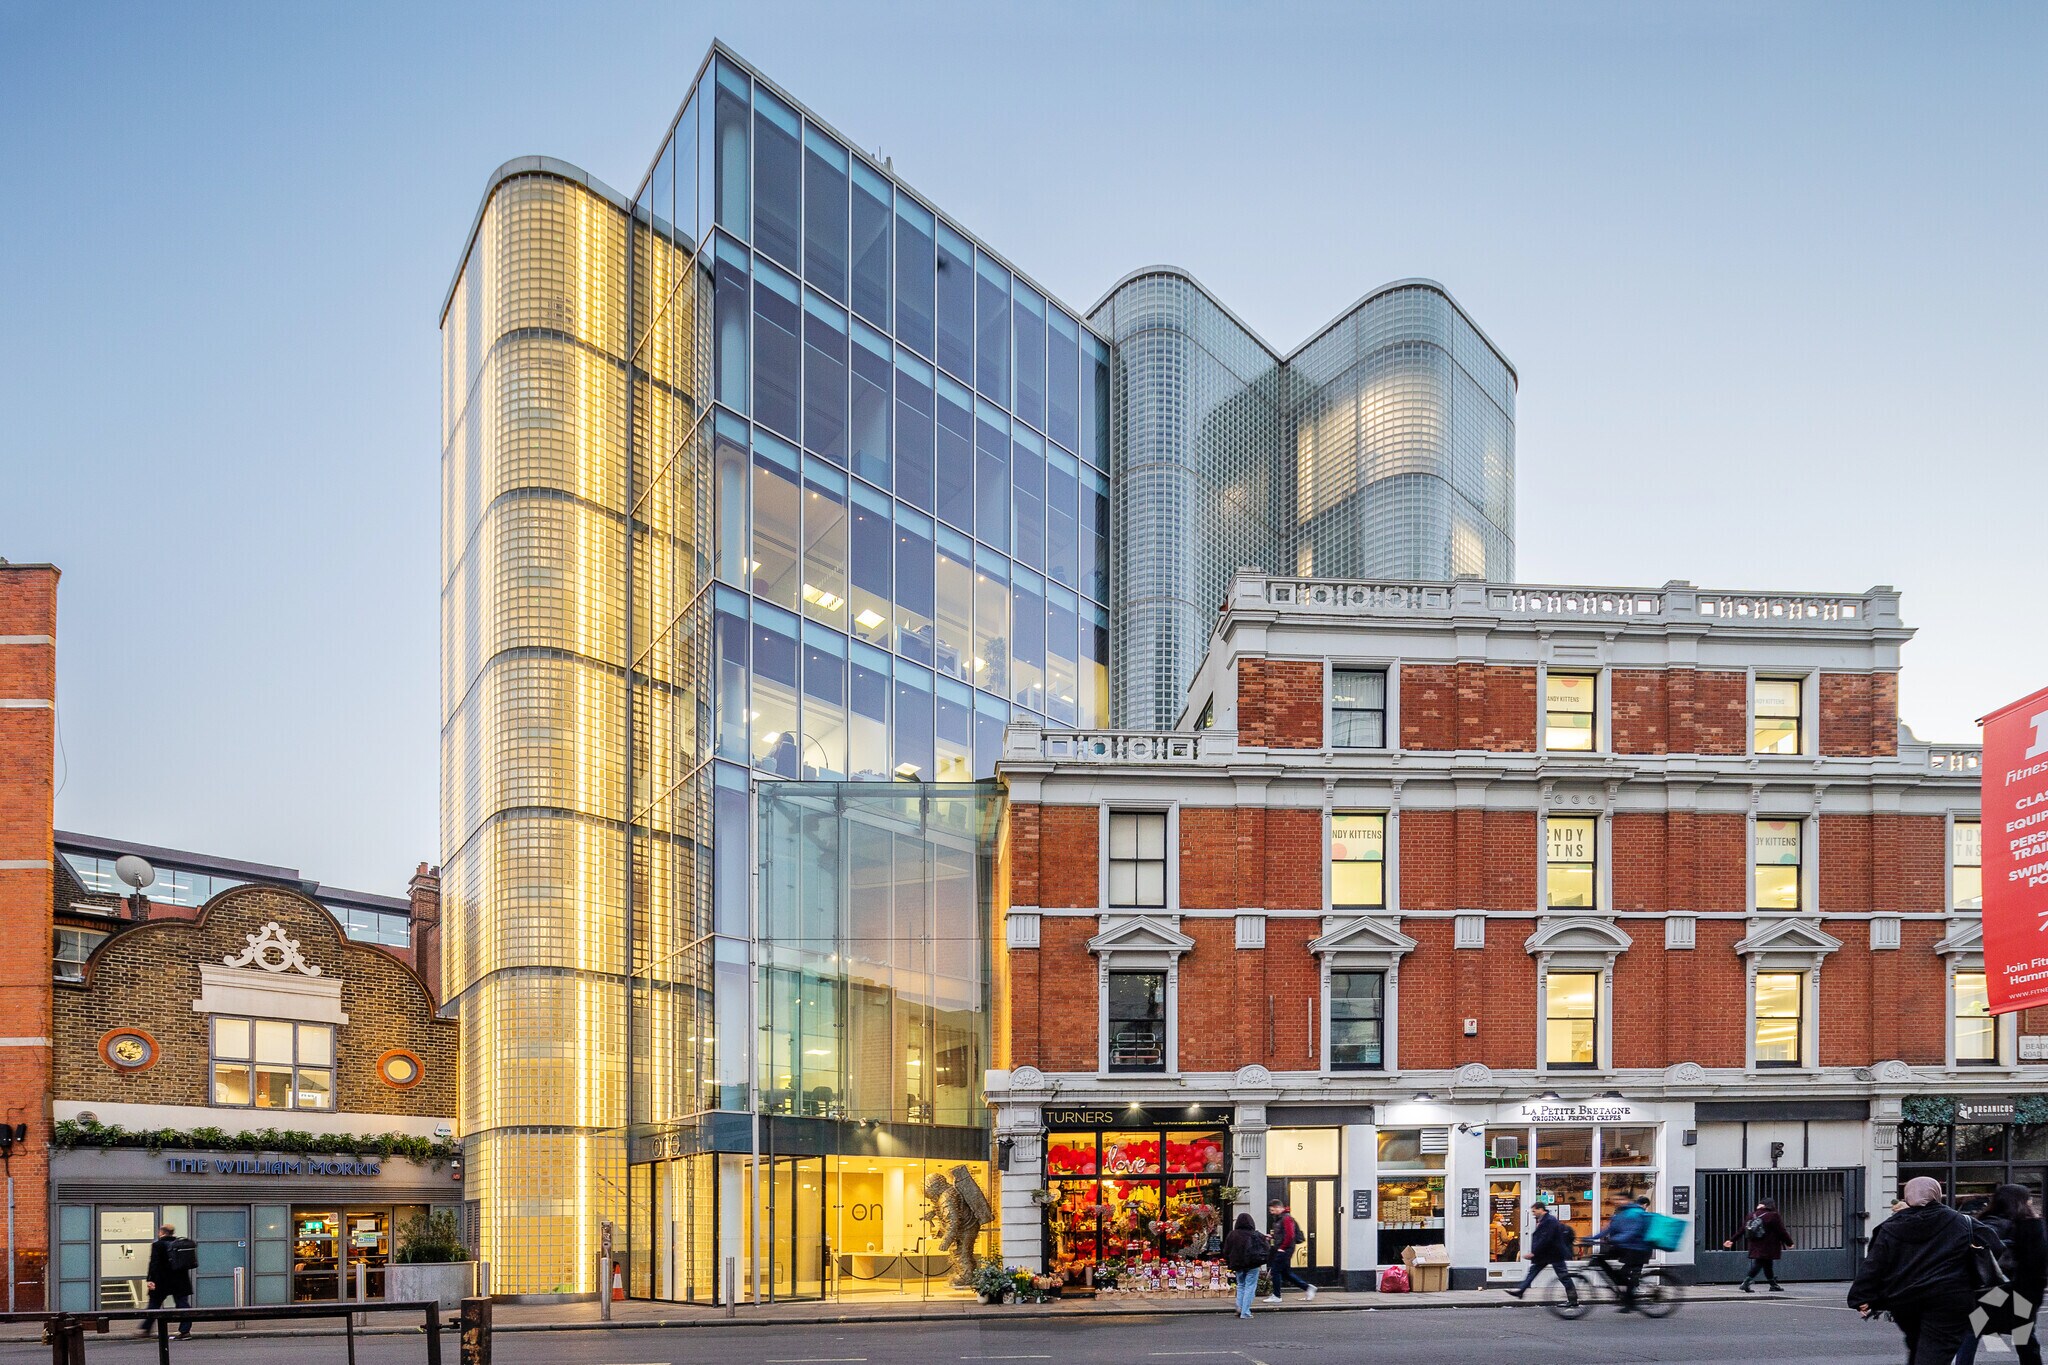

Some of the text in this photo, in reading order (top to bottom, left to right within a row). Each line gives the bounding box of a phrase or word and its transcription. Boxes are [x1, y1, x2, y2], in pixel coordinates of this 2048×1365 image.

[1349, 829, 1382, 839] KITTENS
[2010, 830, 2048, 851] PERS
[1765, 836, 1797, 846] KITTENS
[2003, 962, 2028, 975] Join
[1973, 1104, 2014, 1113] ORGANICOS
[1046, 1111, 1113, 1124] TURNERS
[1297, 1142, 1304, 1152] 5
[1104, 1144, 1147, 1175] love
[167, 1157, 381, 1176] THE WILLIAM MORRIS
